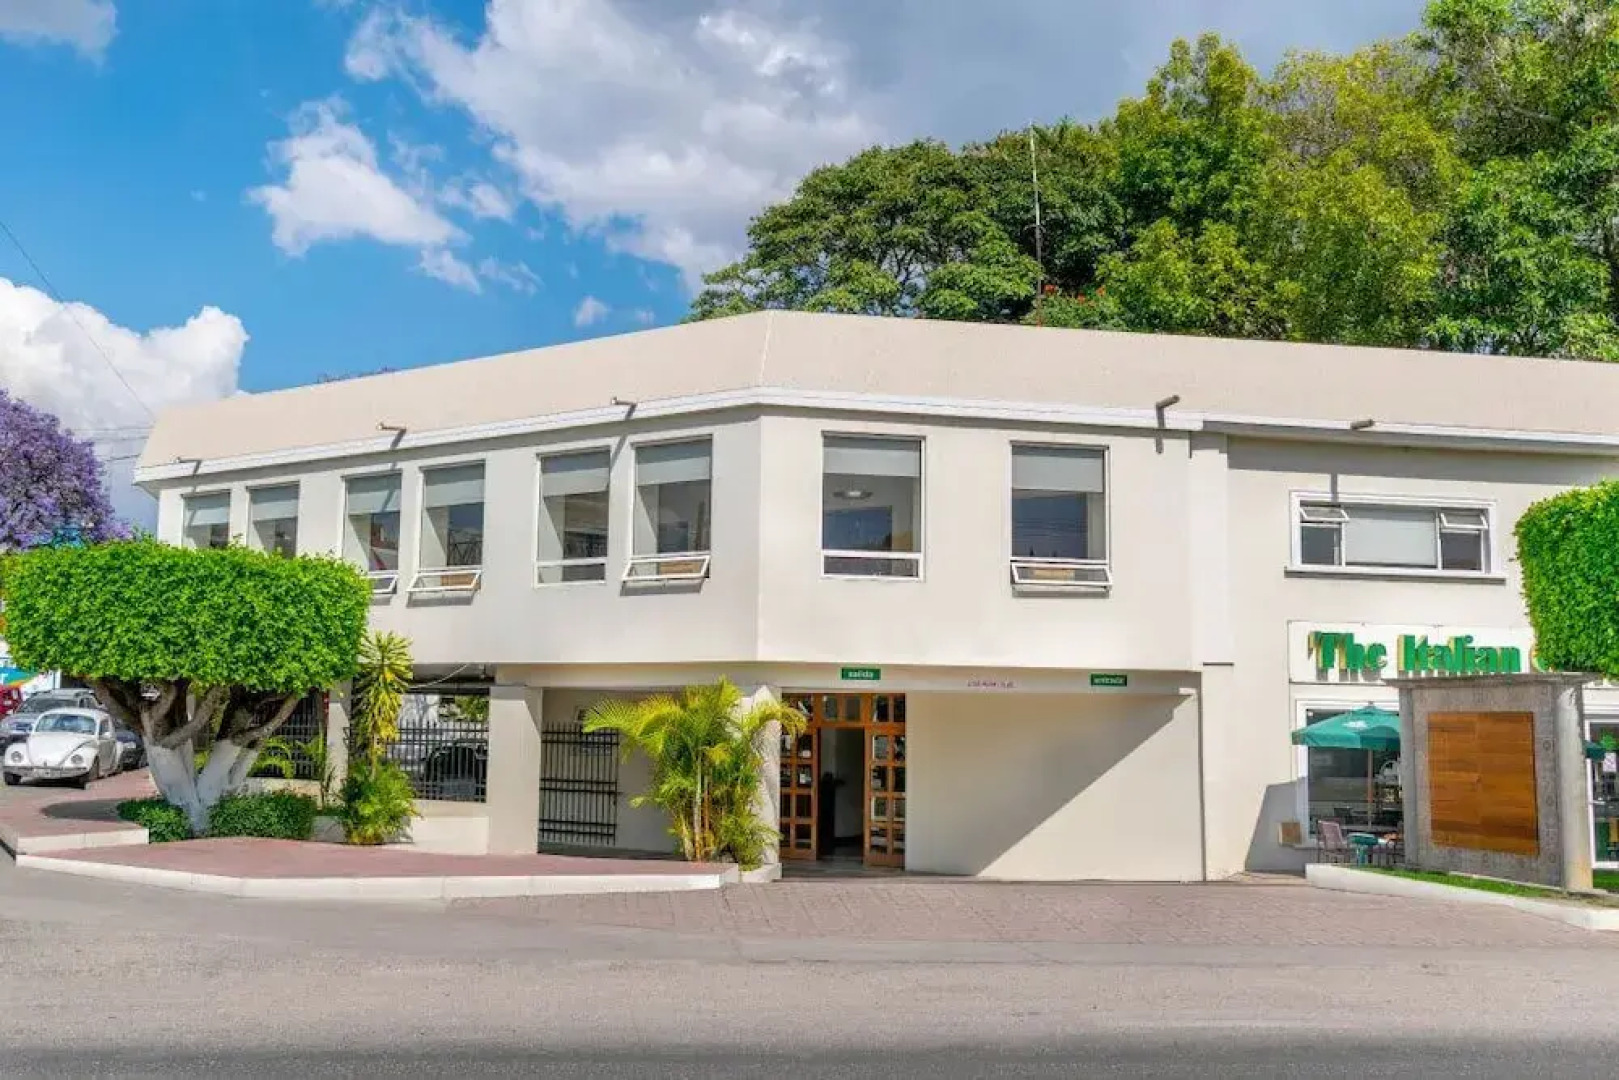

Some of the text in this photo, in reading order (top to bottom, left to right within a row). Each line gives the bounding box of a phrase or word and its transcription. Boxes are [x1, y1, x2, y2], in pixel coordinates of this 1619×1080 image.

[1308, 631, 1387, 669] The
[1397, 635, 1521, 673] Italian
[847, 669, 874, 678] salida
